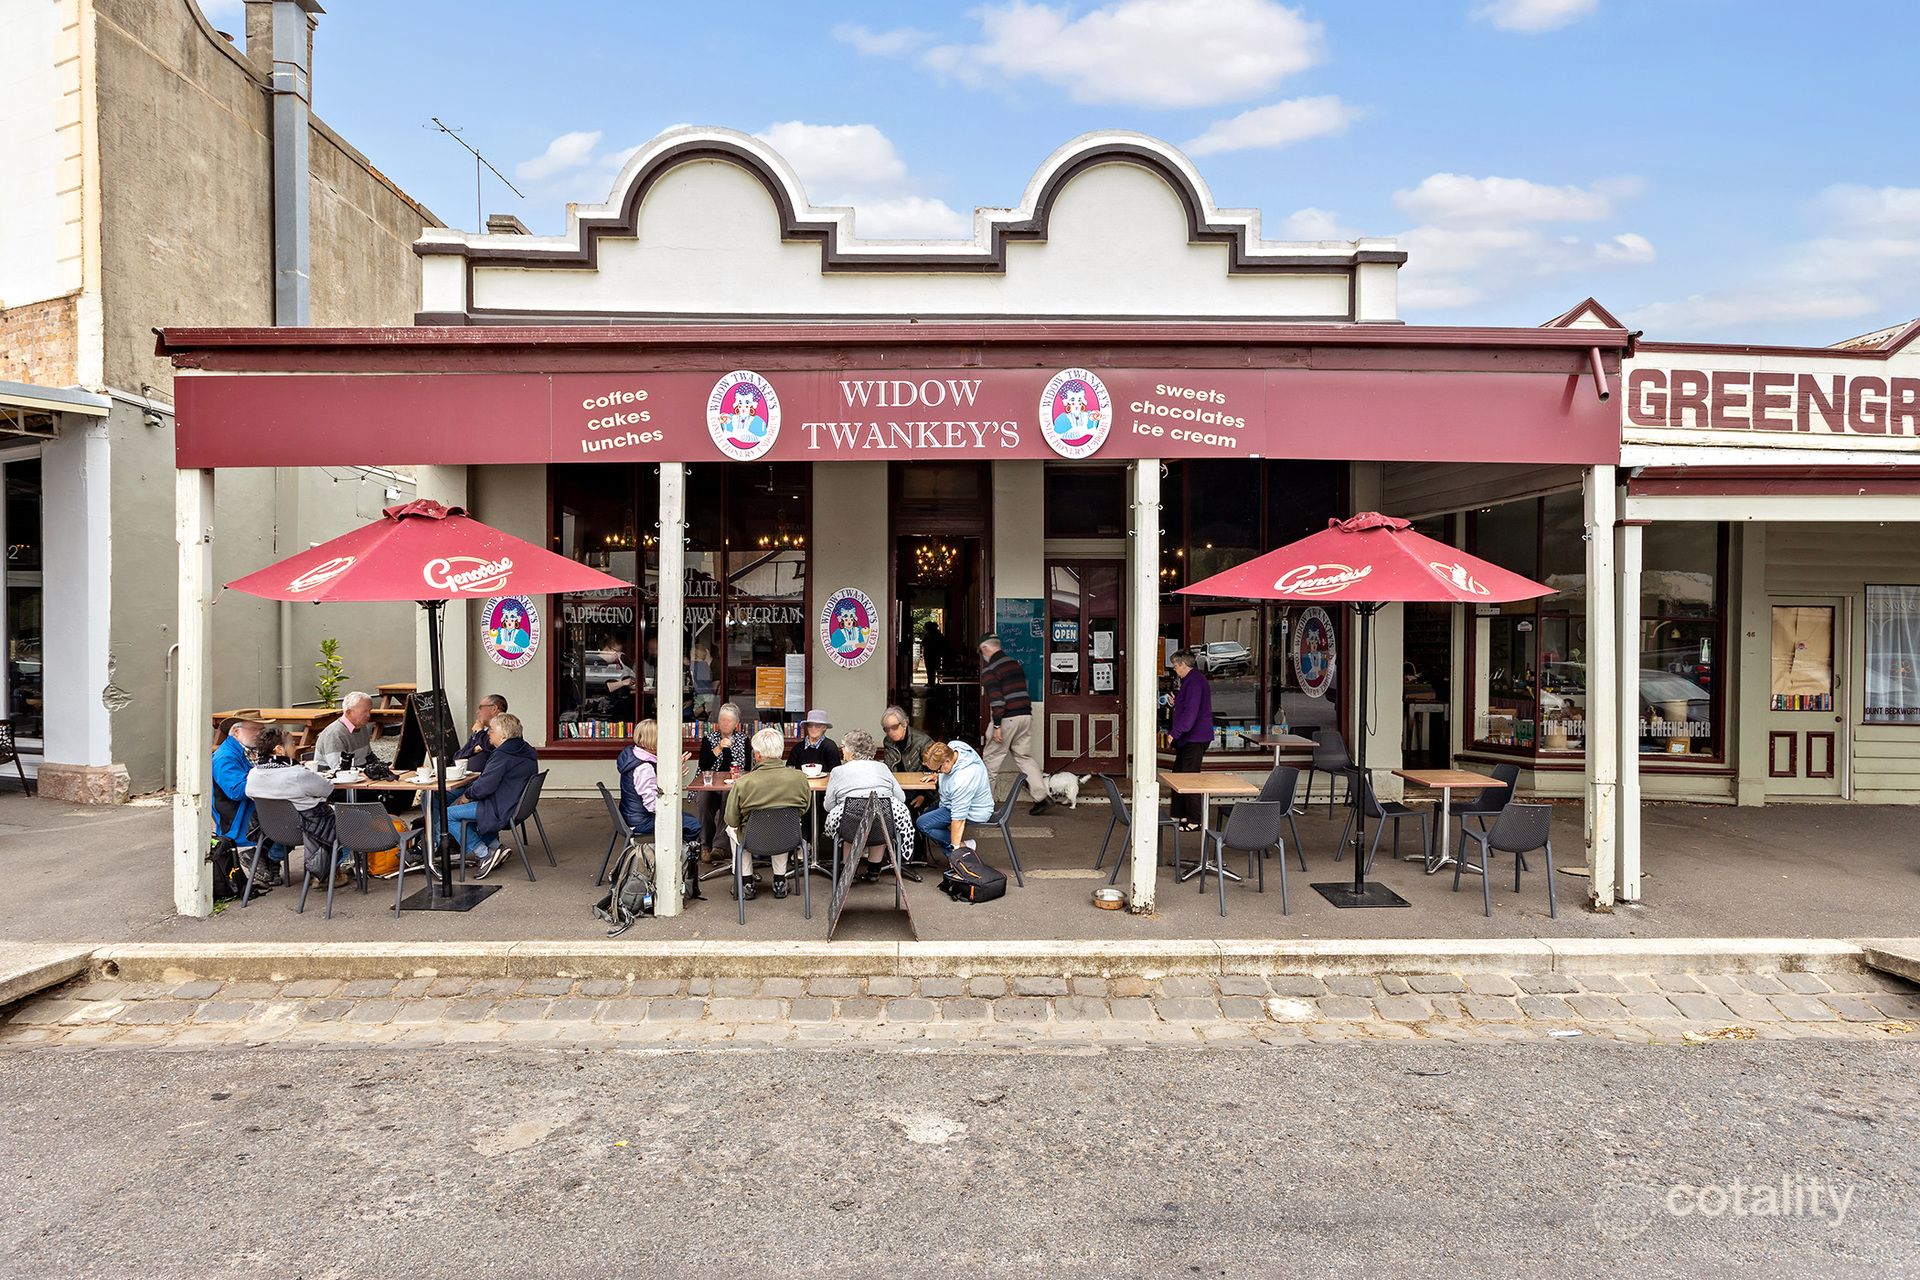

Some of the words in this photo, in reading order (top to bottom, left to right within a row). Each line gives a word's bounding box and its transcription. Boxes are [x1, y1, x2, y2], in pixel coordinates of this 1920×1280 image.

[582, 389, 649, 410] coffee
[709, 378, 730, 411] WIDOW
[839, 379, 983, 407] WIDOW
[1042, 375, 1063, 407] WIDOW
[1155, 383, 1226, 405] sweets
[1628, 368, 1920, 435] GREENGR
[587, 410, 651, 431] cakes
[1129, 400, 1246, 429] chocolates
[581, 430, 664, 454] lunches
[801, 420, 1020, 450] TWANKEY'S
[1132, 420, 1165, 437] ice
[1170, 428, 1237, 449] cream
[423, 557, 514, 593] Genovese
[1273, 565, 1373, 594] Genovese
[481, 596, 498, 627] WIDOW
[563, 606, 633, 624] CAPPUCCINO
[821, 594, 838, 624] WIDOW
[1054, 629, 1077, 639] OPEN
[839, 652, 870, 667] PARLOUR
[1865, 707, 1883, 715] OUNT
[1543, 720, 1558, 736] THE
[1651, 721, 1711, 737] GREENGROCER
